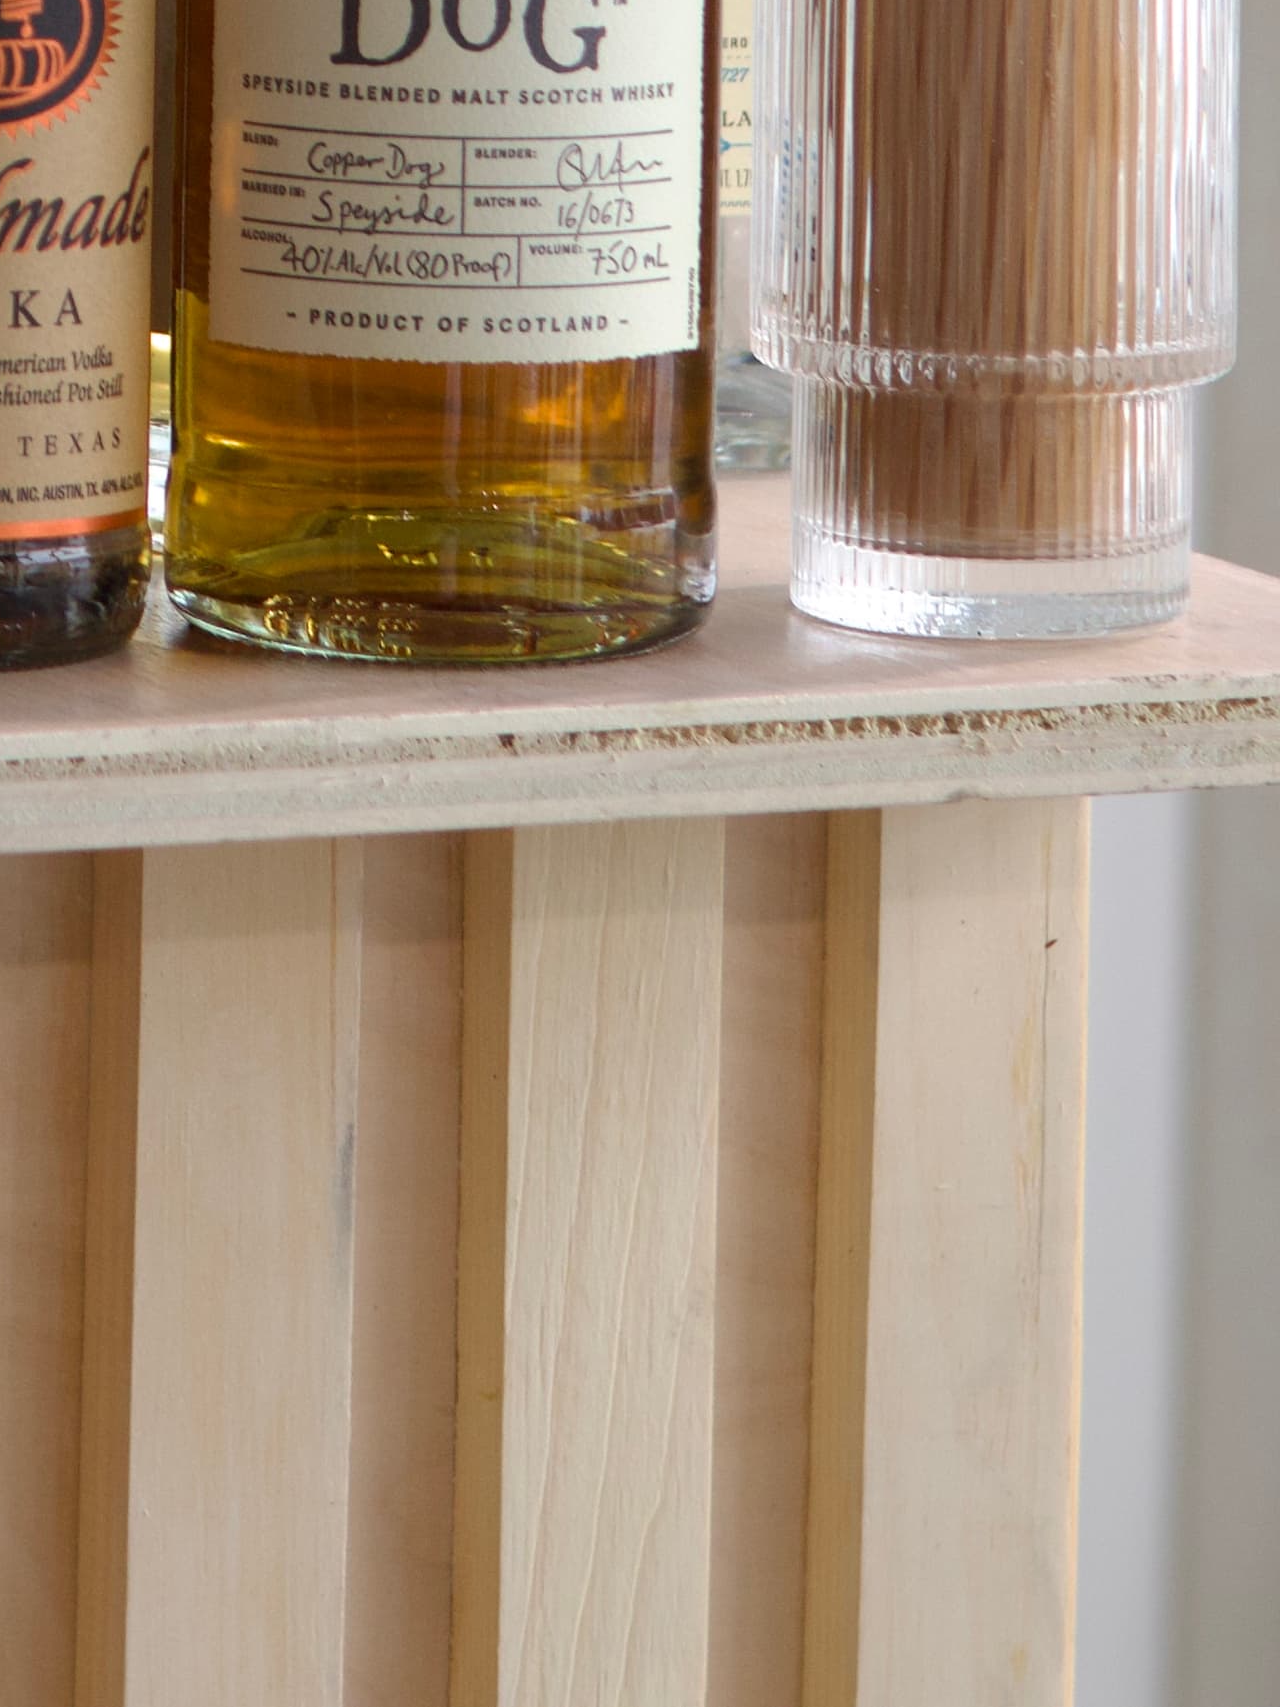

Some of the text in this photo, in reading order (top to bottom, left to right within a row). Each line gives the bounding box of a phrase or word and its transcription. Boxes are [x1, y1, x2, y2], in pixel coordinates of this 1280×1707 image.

[241, 73, 675, 106] SPEYSIDE BLENDED MALT SCOTCH WHISKY
[243, 131, 279, 147] BLEND:
[307, 141, 445, 189] Copper Dog
[474, 148, 537, 160] BLENDER:
[242, 180, 306, 198] MARRIED IN:
[311, 190, 455, 235] Speyside
[474, 196, 542, 210] BATCH NO.
[558, 190, 635, 242] 16/0673
[241, 228, 294, 246] ALCOHOL:
[529, 244, 582, 256] VOLUME:
[587, 240, 637, 276] 750
[406, 248, 448, 280] (80
[452, 251, 512, 283] Proof)
[310, 309, 610, 334] PRODUCT OF SCOTLAND
[70, 348, 113, 370] Vodka
[67, 378, 93, 401] Pot
[96, 374, 124, 398] Still
[17, 427, 123, 458] TEXAS
[17, 486, 40, 502] INC.
[42, 483, 85, 500] AUSTIN,
